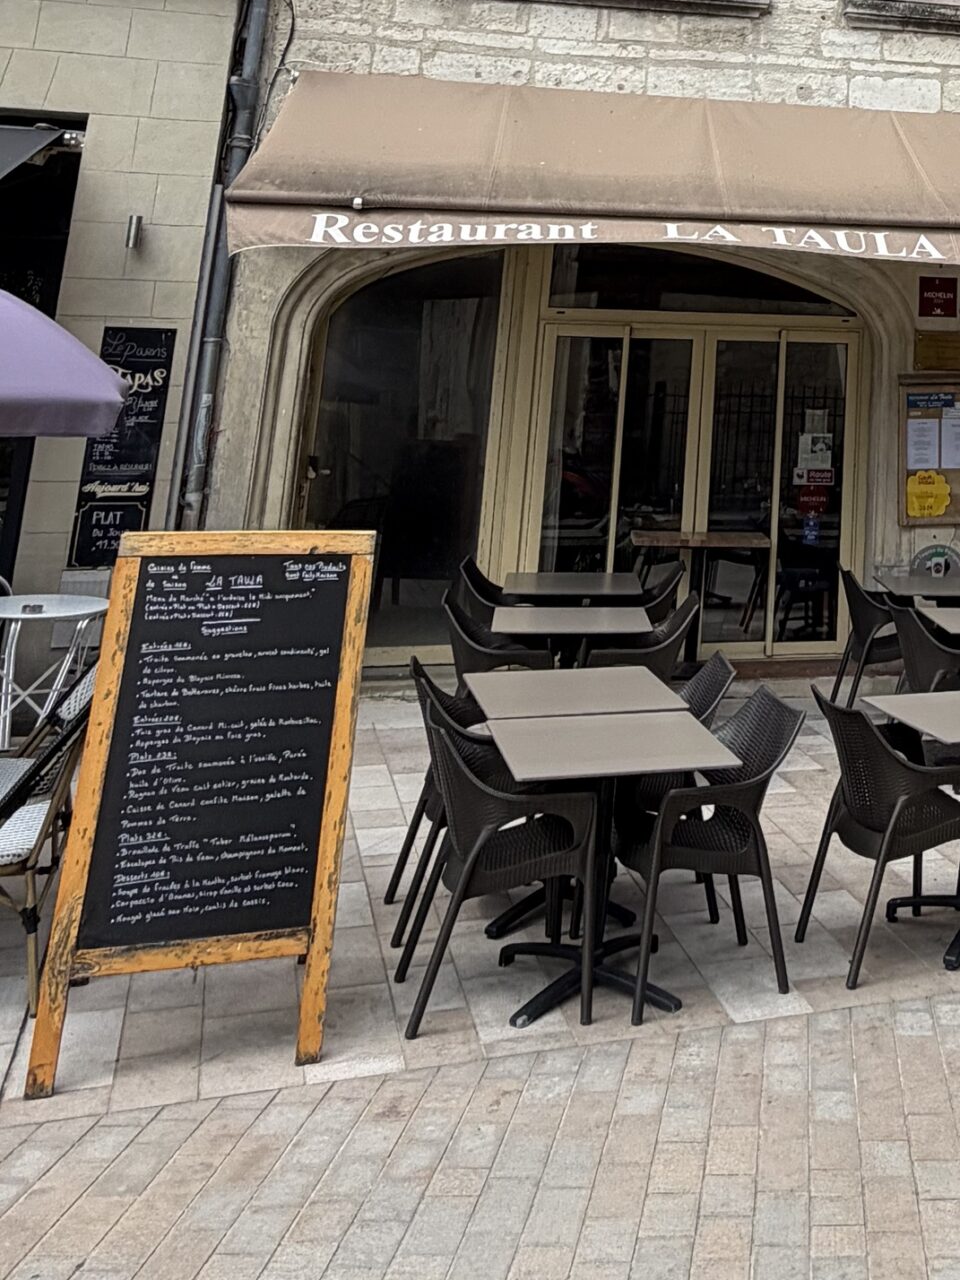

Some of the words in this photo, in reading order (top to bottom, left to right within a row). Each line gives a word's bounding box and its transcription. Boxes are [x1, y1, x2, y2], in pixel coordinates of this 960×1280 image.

[307, 213, 598, 246] Restaurant
[664, 223, 742, 243] LA
[762, 226, 945, 260] TAULA
[82, 480, 150, 494] Aujourd'hui
[92, 511, 123, 525] PLAT
[205, 575, 224, 587] LA
[229, 575, 263, 586] TAULA
